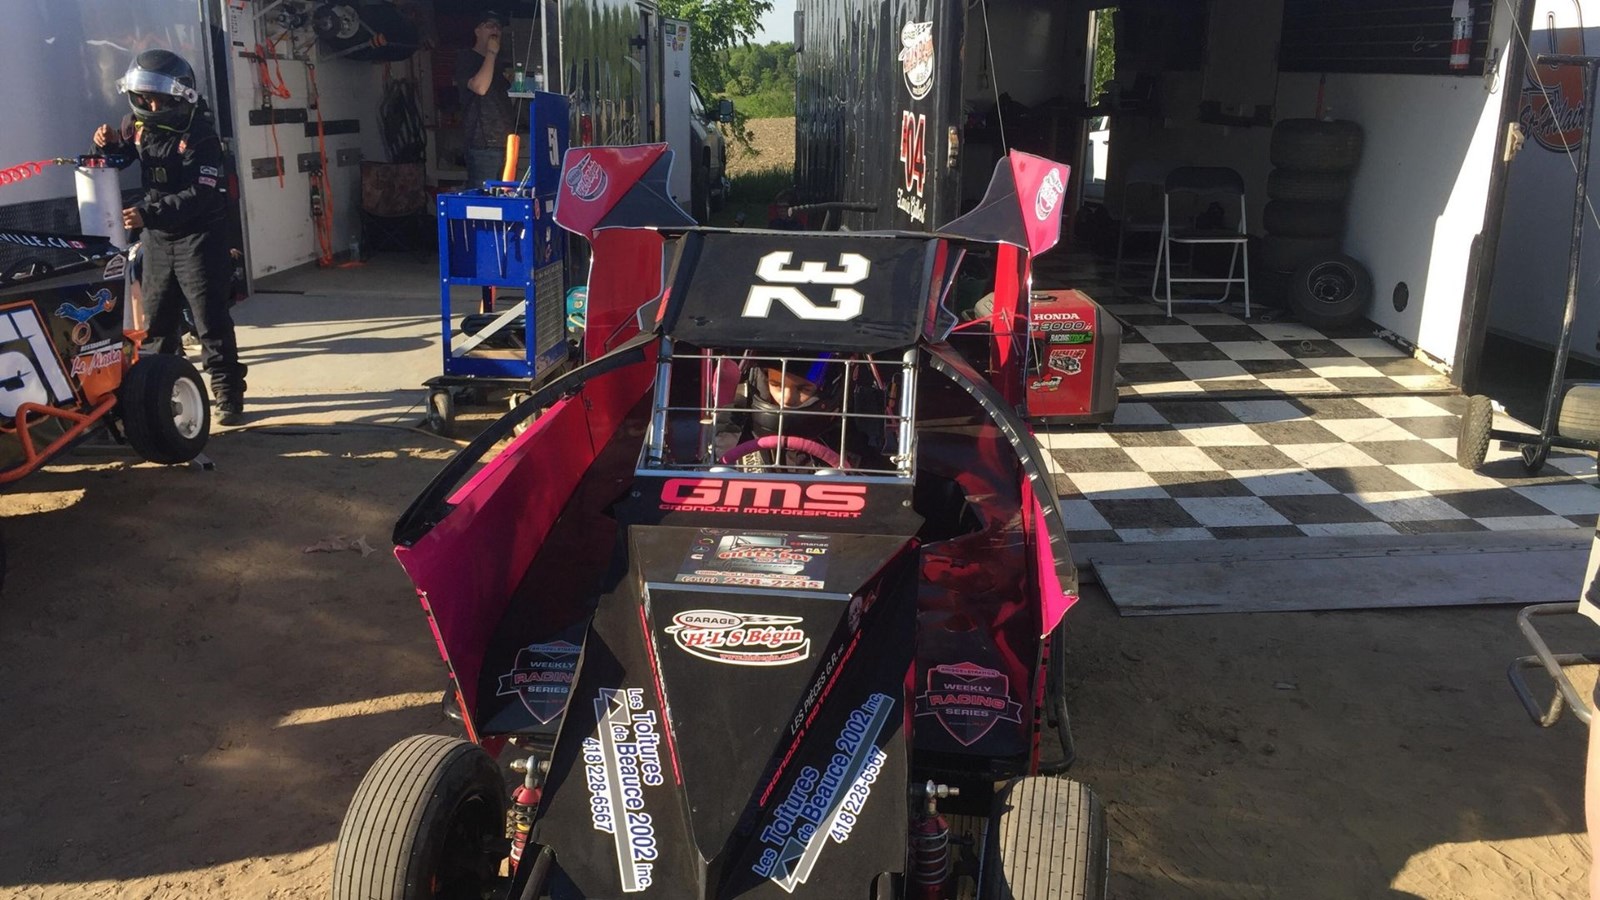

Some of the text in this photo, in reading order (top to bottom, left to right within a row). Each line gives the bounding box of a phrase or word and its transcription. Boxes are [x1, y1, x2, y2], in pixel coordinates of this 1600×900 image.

[0, 233, 72, 249] VILLE.CA
[740, 250, 872, 322] 32
[660, 478, 867, 511] GMS
[659, 503, 862, 518] GRONDIN MOTORSPORT
[685, 615, 736, 625] GARAGE
[728, 630, 743, 645] S
[745, 625, 802, 646] Bégin
[530, 661, 576, 669] WEEKLY
[514, 672, 573, 685] RACIN
[943, 683, 992, 692] WEEKLY
[527, 685, 569, 694] SERIES
[628, 688, 643, 709] Les
[790, 709, 805, 736] LES
[803, 671, 827, 709] PIÈCES
[928, 693, 1006, 710] RACING
[759, 629, 863, 807] GRONDIN MOTORSPORT
[945, 708, 989, 717] SERIES
[634, 711, 662, 785] Toitures
[799, 692, 883, 842] de Beauce 2002 inc.
[584, 738, 613, 833] 418 228-6567
[831, 746, 886, 842] 418 228-6567
[614, 726, 657, 890] de Beauce 2002 inc.
[753, 766, 819, 875] Les Toitures
